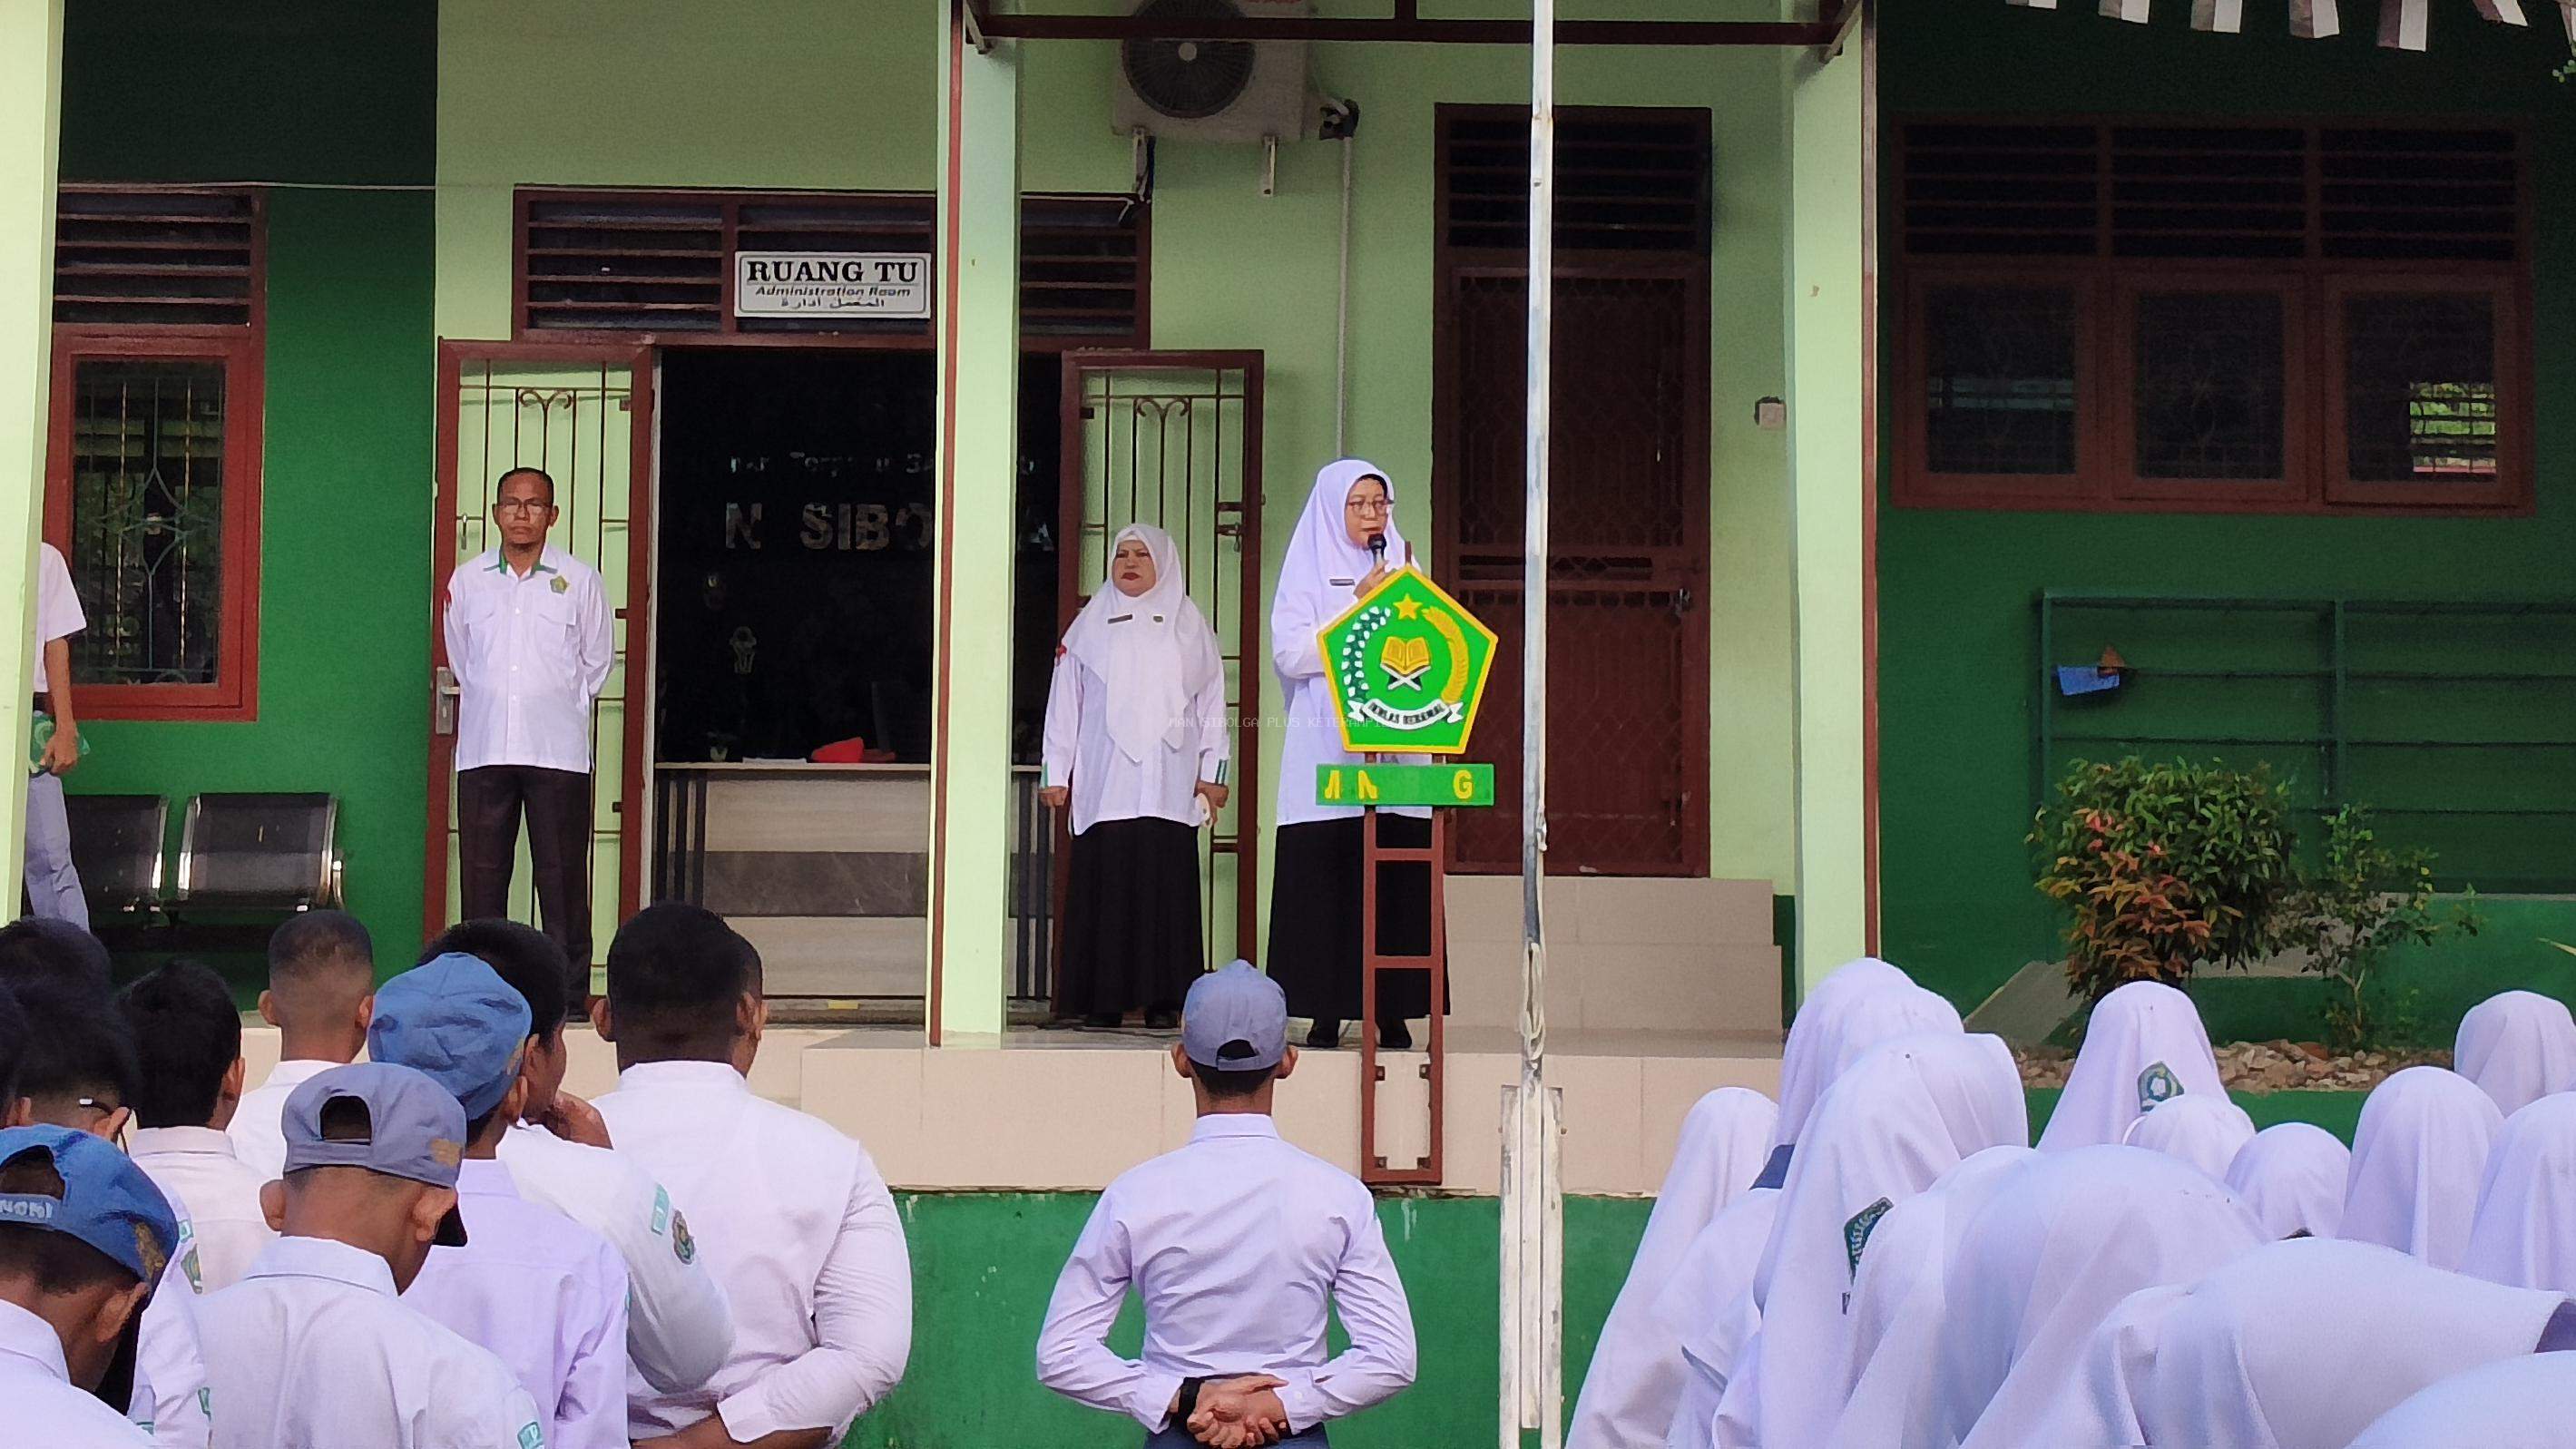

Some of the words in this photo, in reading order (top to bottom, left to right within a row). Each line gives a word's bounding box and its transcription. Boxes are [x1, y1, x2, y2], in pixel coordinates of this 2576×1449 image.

[747, 260, 864, 282] RUANG
[874, 261, 918, 282] TU
[755, 286, 864, 297] Administration
[868, 287, 911, 298] Room
